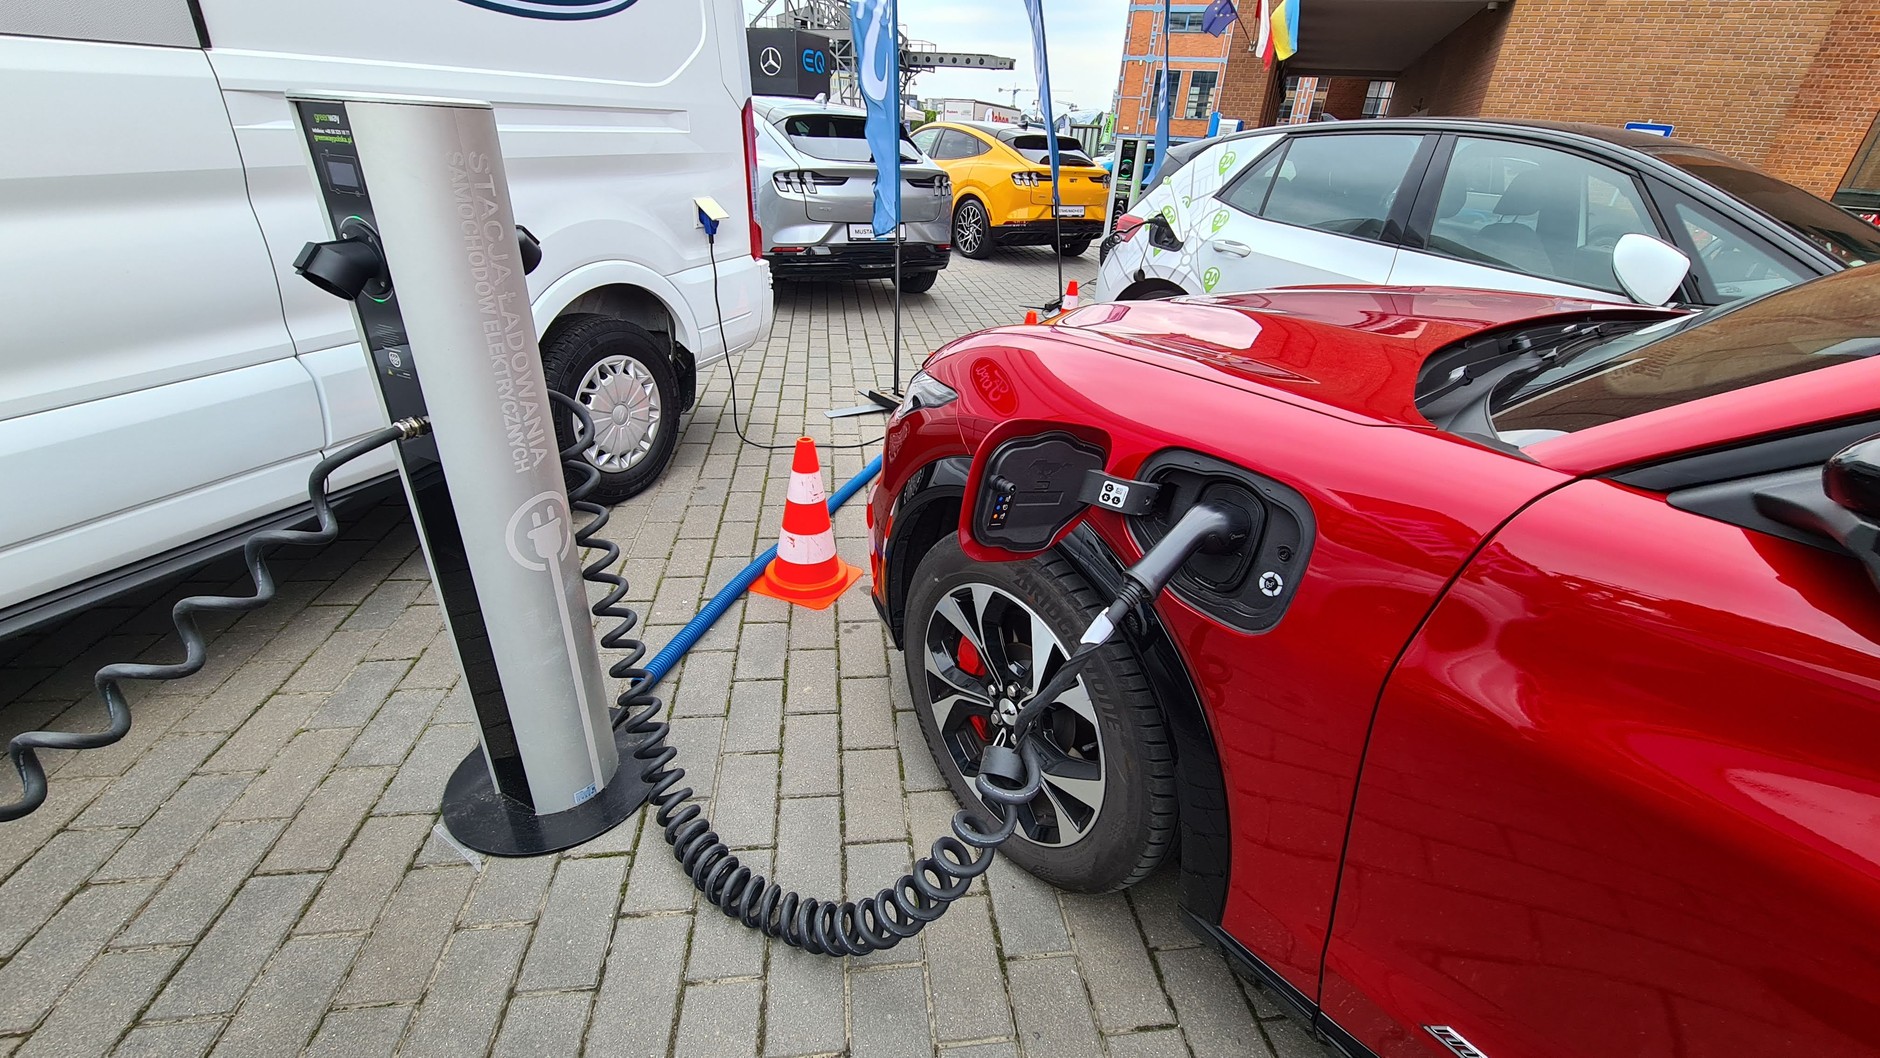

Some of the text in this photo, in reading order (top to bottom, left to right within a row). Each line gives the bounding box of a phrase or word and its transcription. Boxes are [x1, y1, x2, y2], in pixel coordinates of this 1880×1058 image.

[313, 113, 340, 124] greenway
[802, 48, 825, 74] EQ
[447, 151, 531, 474] SAMOCHODÓW ELEKTRYCZNYCH
[468, 151, 548, 467] STACJA ŁADOWANIA
[1011, 569, 1123, 732] BRIDGETONE
